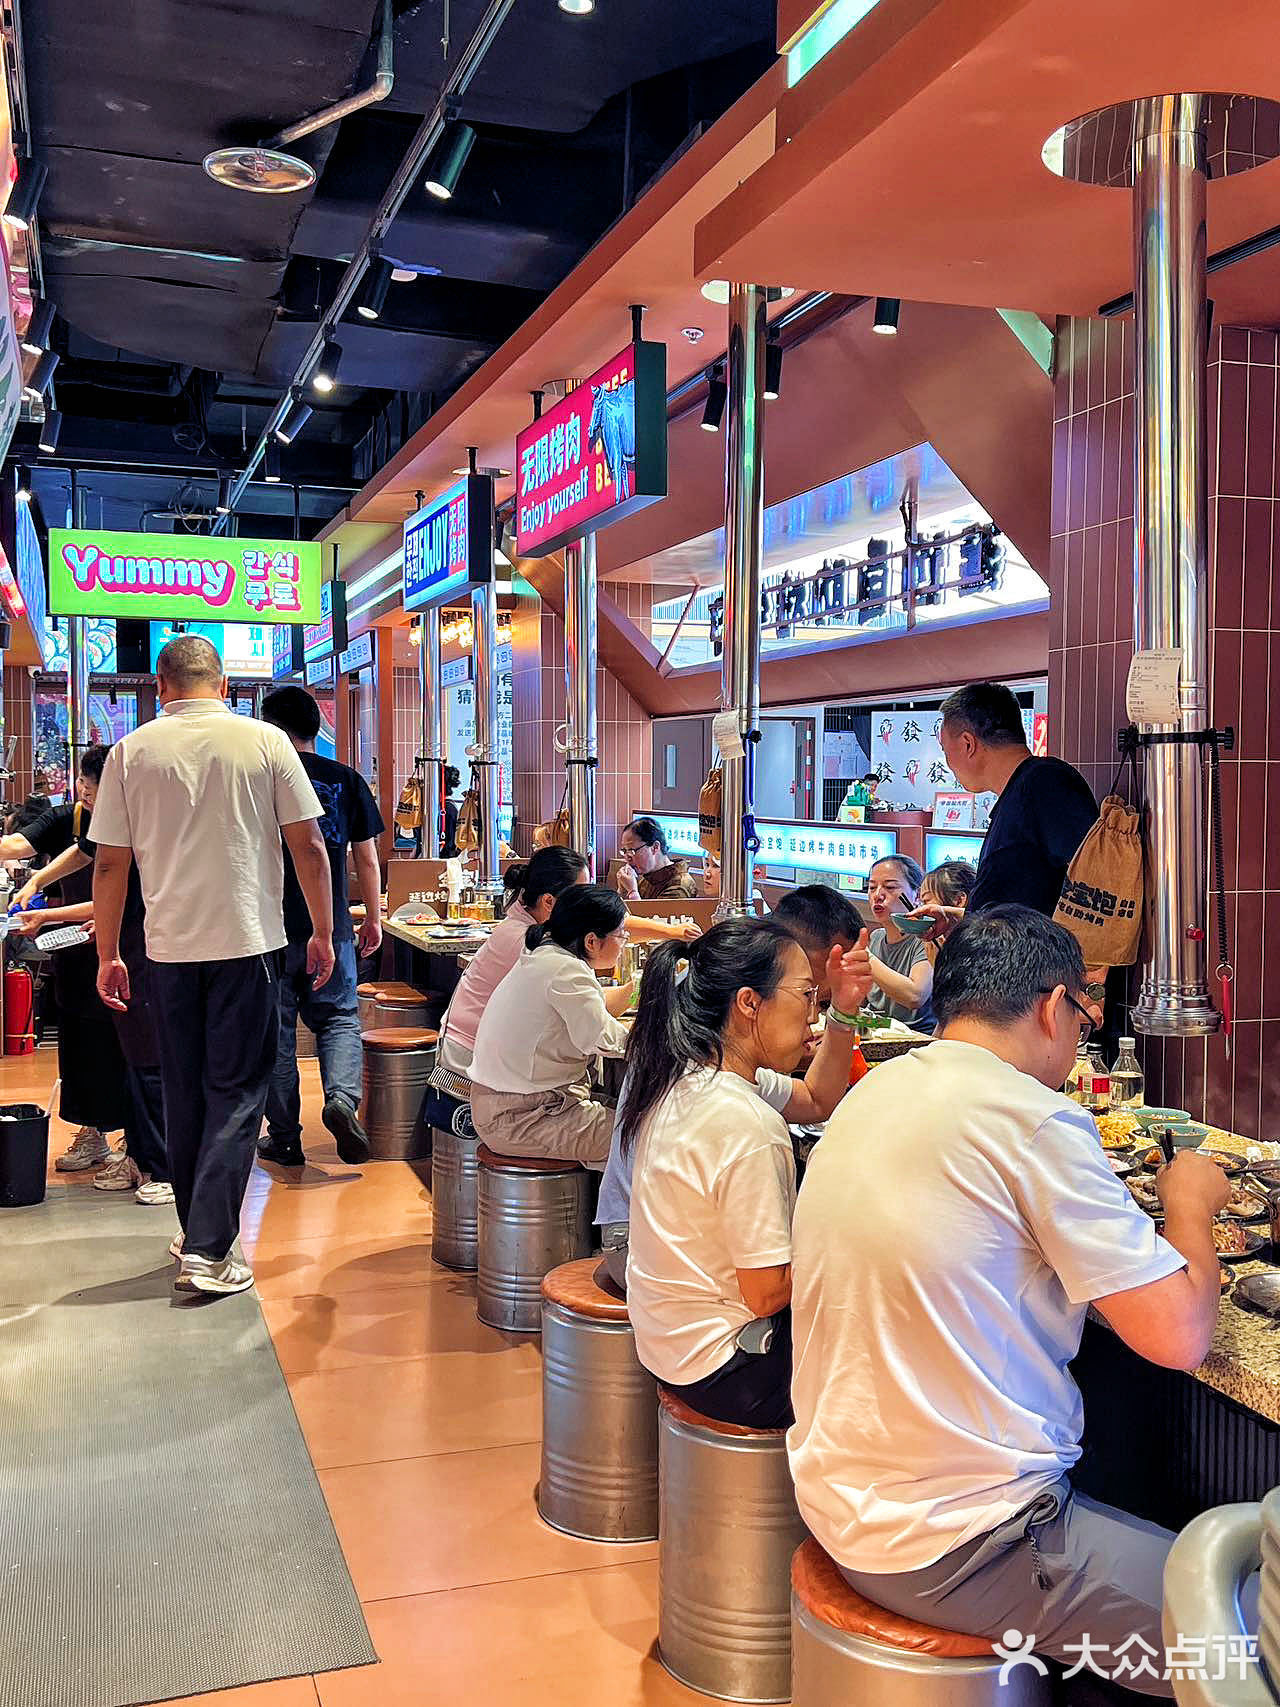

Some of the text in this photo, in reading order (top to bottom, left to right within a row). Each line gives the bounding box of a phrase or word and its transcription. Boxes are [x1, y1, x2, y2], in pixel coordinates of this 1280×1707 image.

[521, 412, 581, 497] 无限烤肉
[521, 465, 589, 533] Enjoy yourself
[62, 543, 236, 607] Yummy
[419, 510, 449, 583] ENJOY
